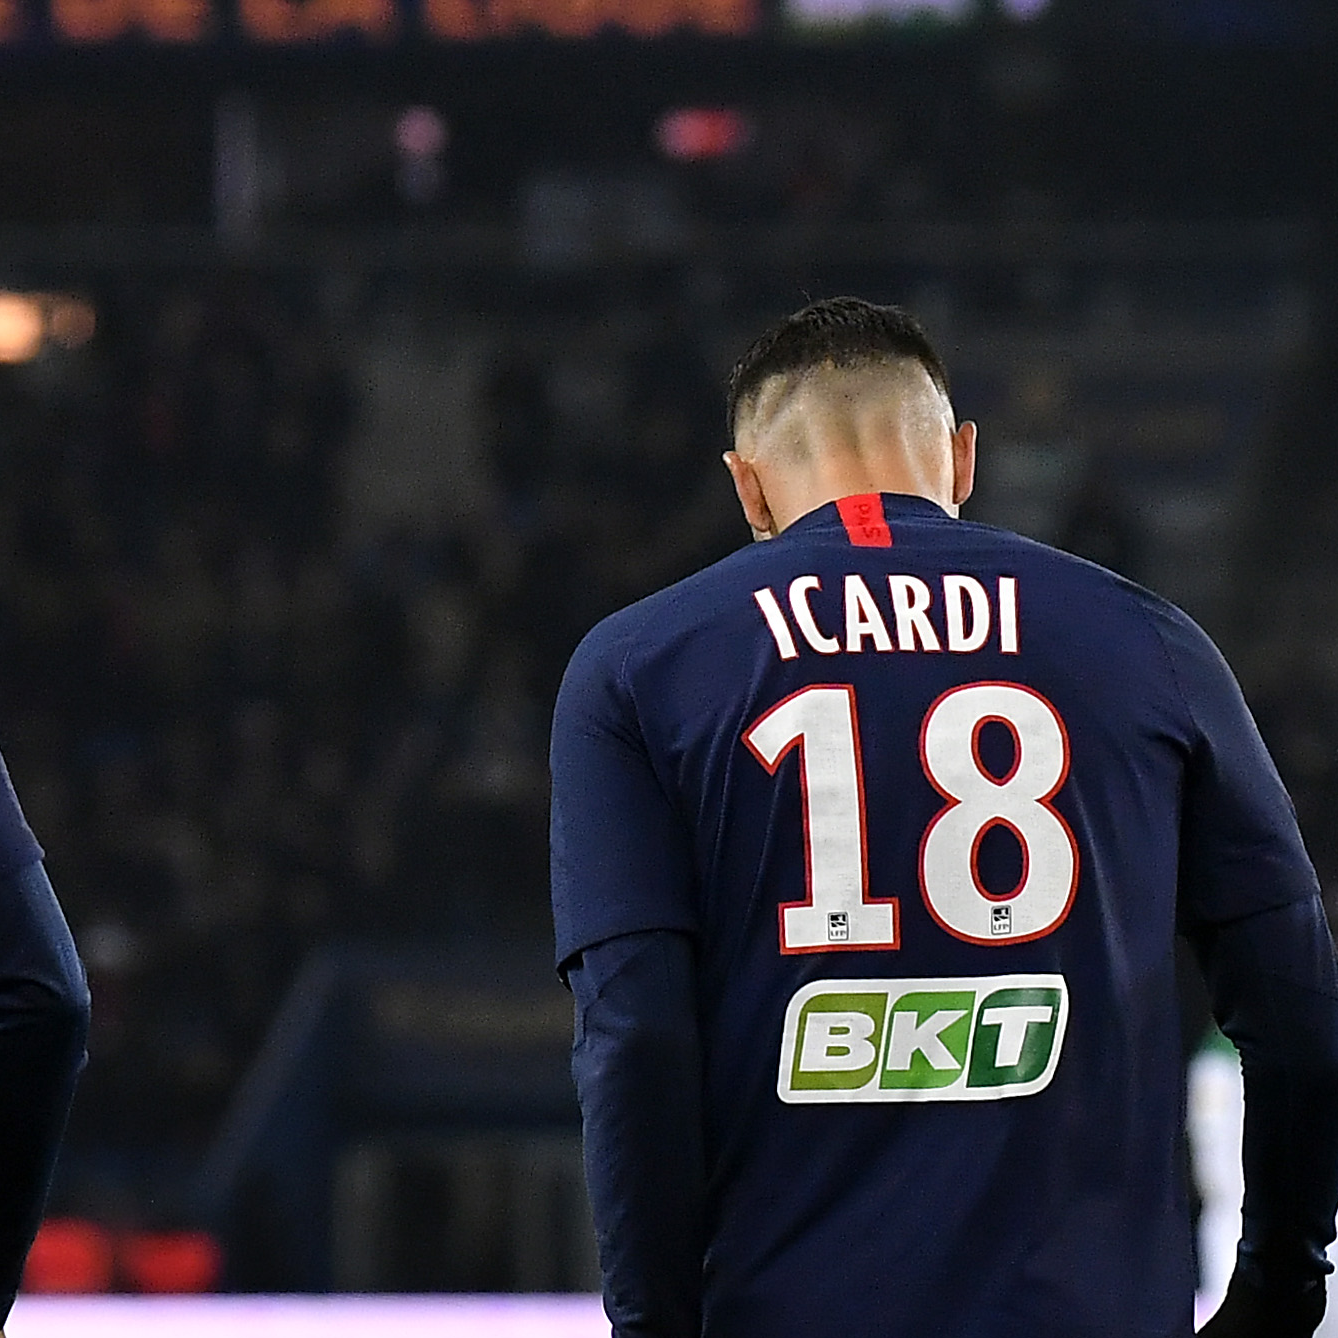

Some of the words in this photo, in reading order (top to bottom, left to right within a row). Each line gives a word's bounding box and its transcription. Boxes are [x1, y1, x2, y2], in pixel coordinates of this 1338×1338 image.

[753, 573, 1020, 661] ICARDI
[741, 680, 1080, 955] 18
[798, 1005, 1054, 1072] BKT
